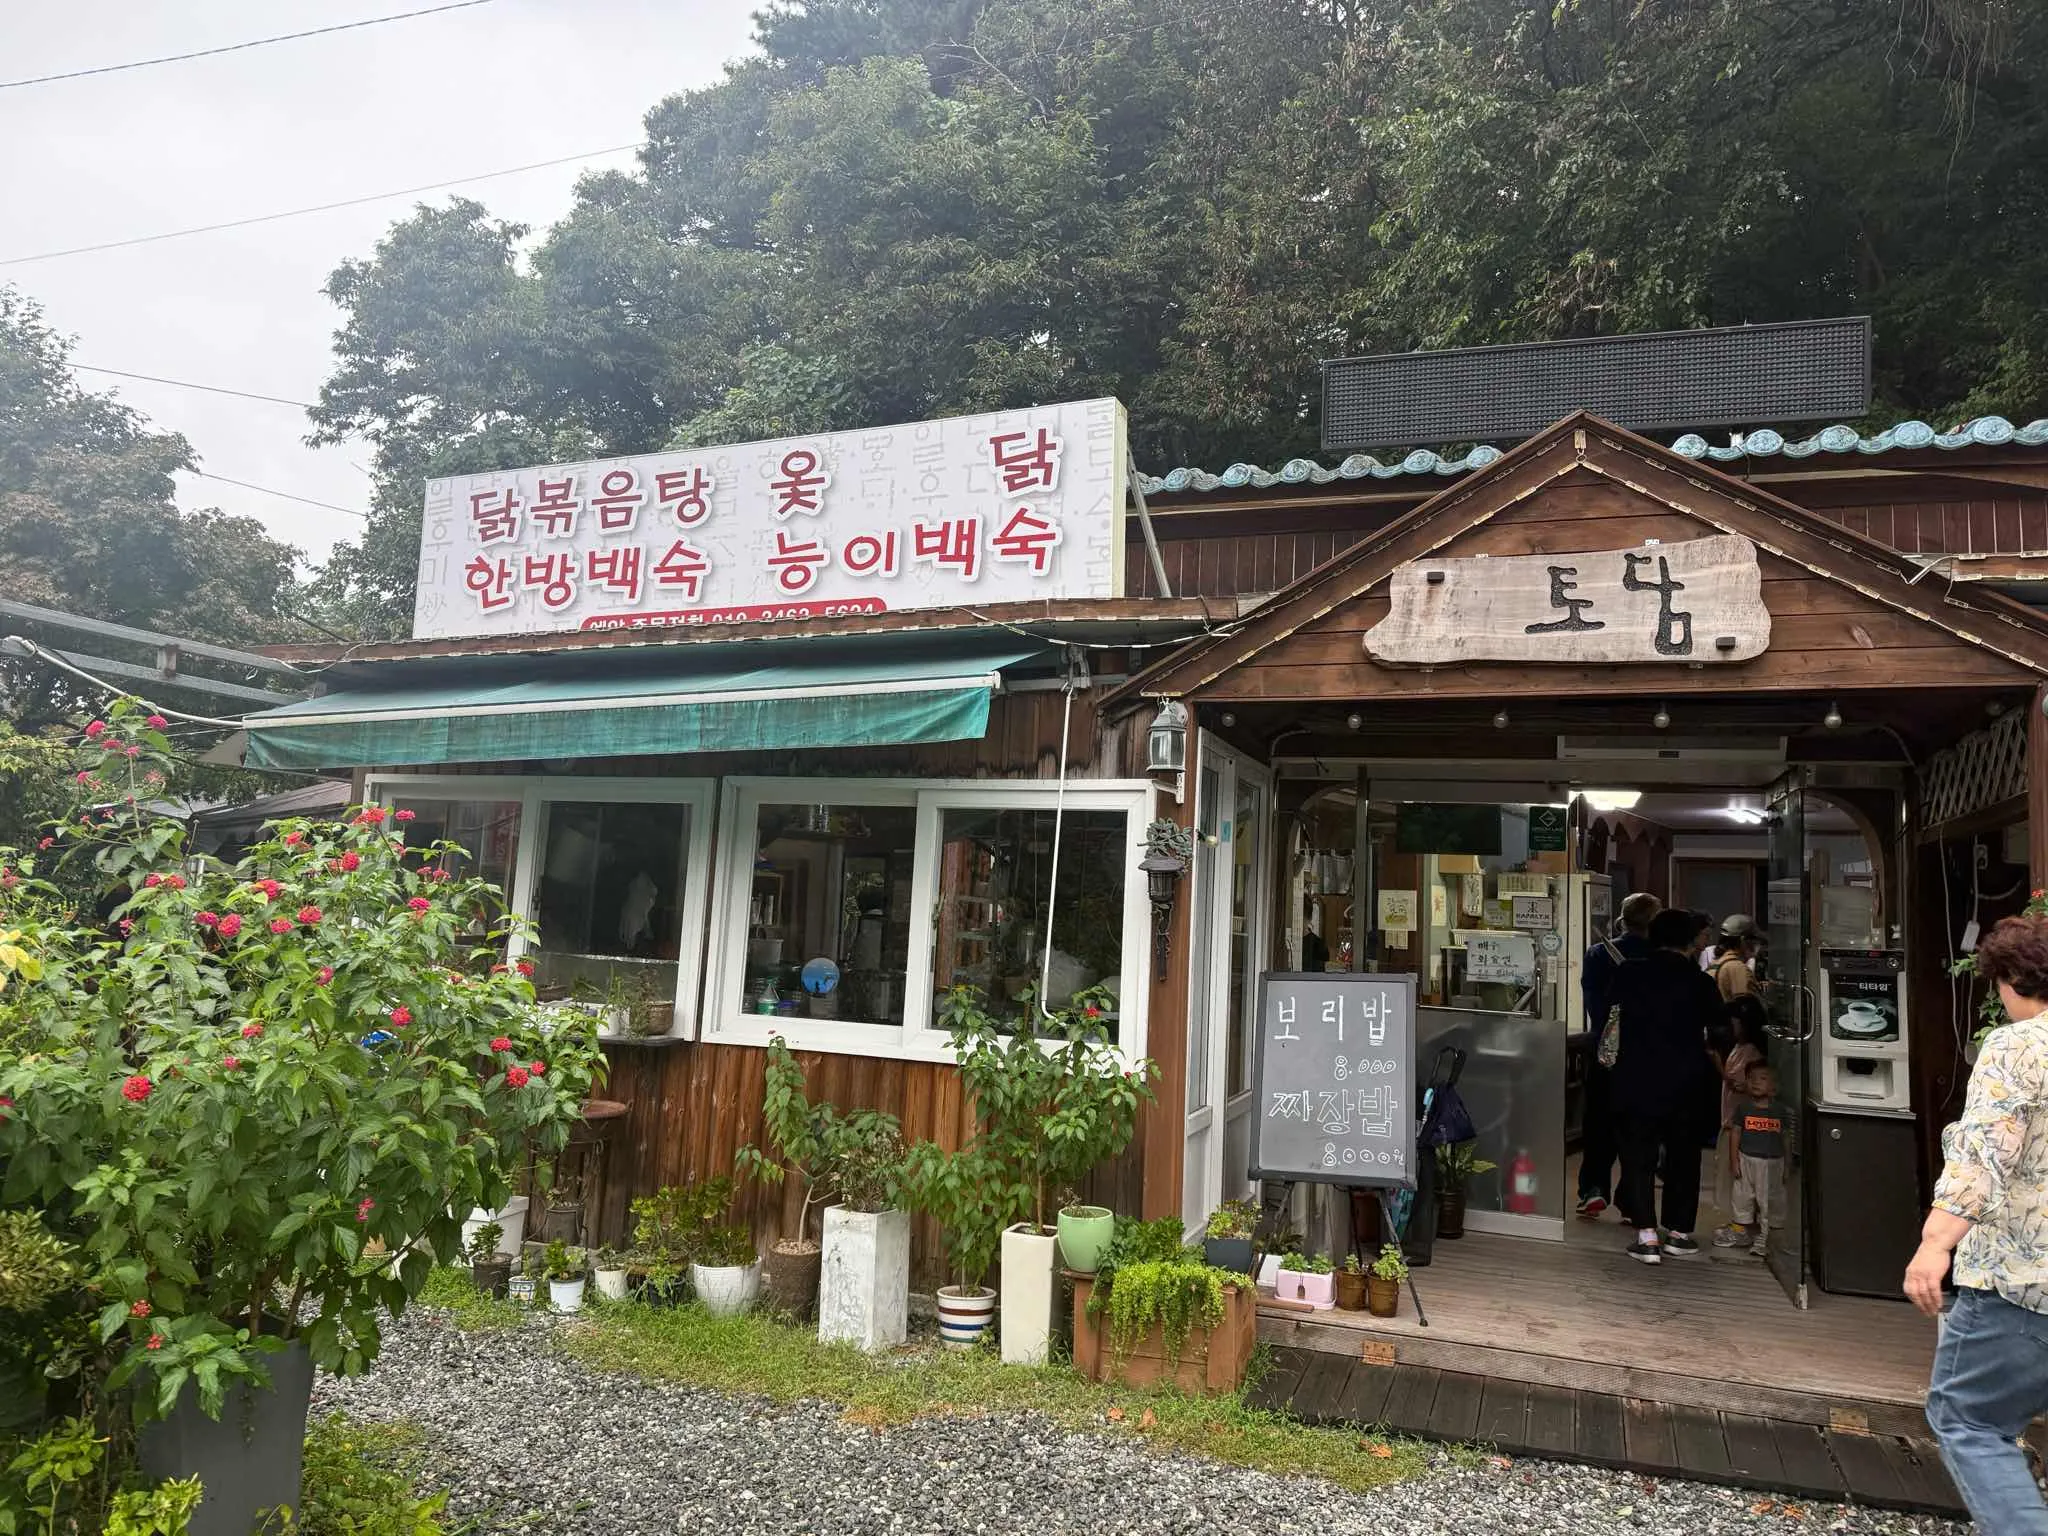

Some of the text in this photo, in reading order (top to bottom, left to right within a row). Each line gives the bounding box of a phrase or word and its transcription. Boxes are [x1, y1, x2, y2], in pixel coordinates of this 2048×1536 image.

[470, 468, 710, 542] 닭볶음탕
[989, 428, 1057, 492] 닭
[465, 539, 706, 608] 한방백숙
[767, 508, 1056, 590] 능이백숙
[1525, 553, 1692, 655] 토담
[1273, 991, 1392, 1044] 보리밥
[1334, 1055, 1396, 1080] 8.000
[1268, 1085, 1399, 1137] 짜장밥
